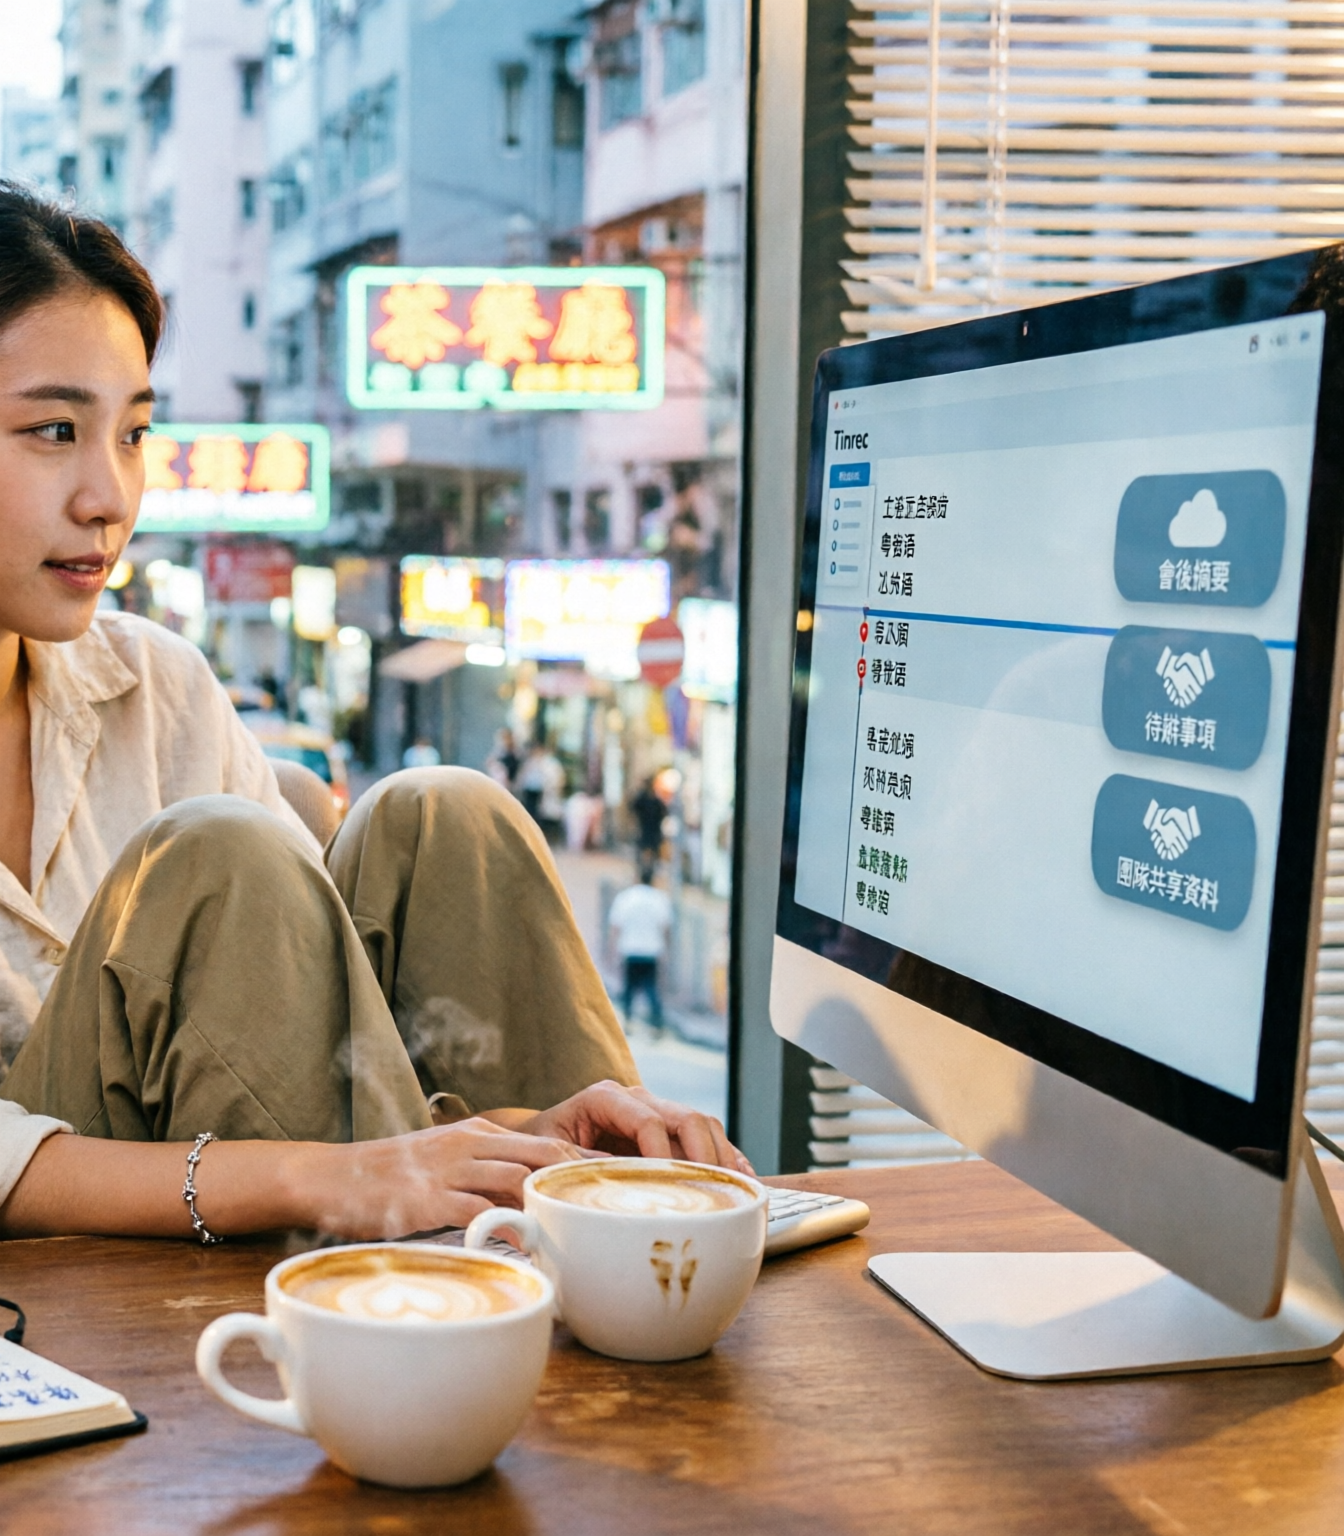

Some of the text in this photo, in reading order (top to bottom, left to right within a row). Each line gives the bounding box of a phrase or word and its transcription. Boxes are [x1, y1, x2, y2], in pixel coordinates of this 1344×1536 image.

[834, 429, 869, 451] Tinrec
[1158, 558, 1231, 593] 會後摘要
[1116, 855, 1219, 913] 團隊共享資料
